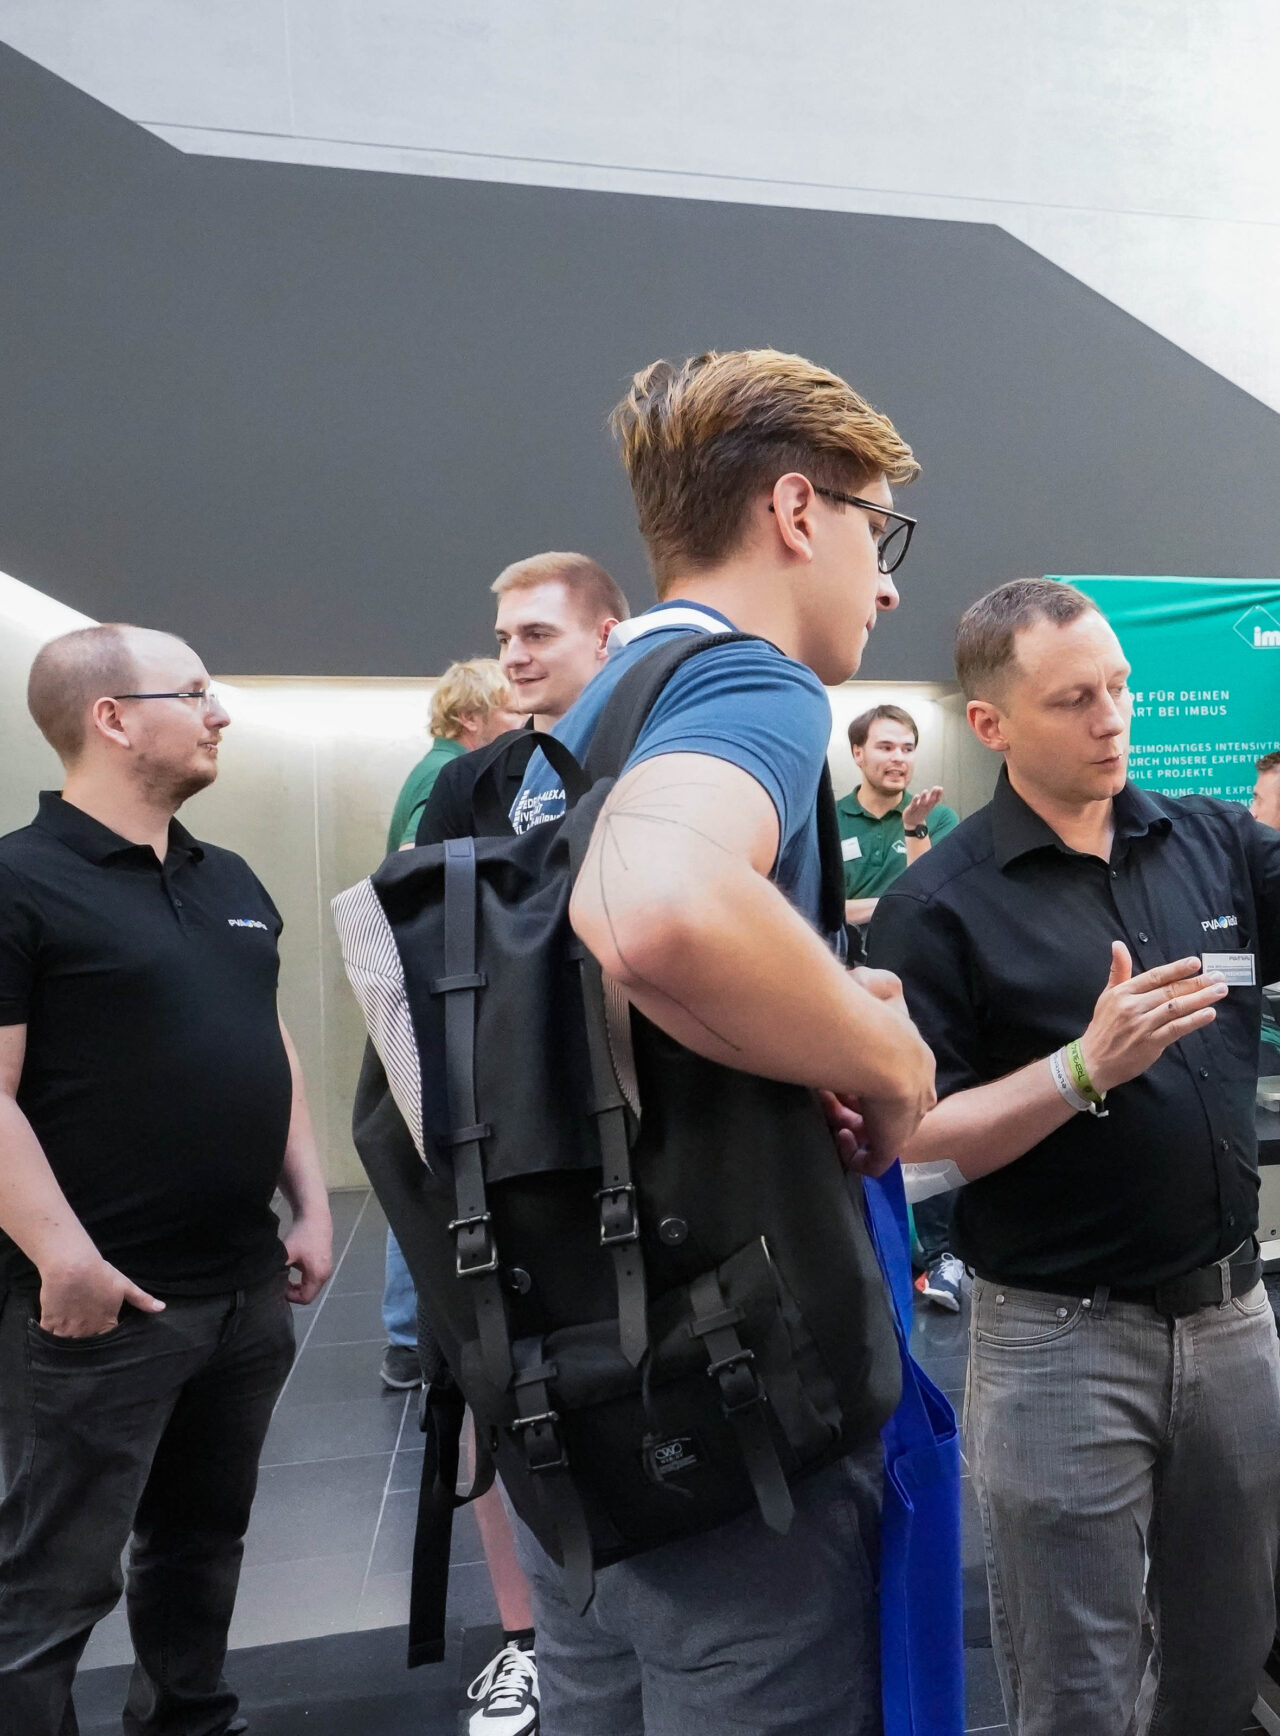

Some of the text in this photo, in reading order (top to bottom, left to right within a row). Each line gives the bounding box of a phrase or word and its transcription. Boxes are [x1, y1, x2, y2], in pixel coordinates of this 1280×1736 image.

[1148, 689, 1175, 702] FÜR
[1180, 690, 1230, 701] DEINEN
[1158, 706, 1180, 717] BEI
[1185, 705, 1228, 717] IMBUS
[1129, 743, 1212, 755] REIMONATIGES
[1129, 757, 1160, 768] URCH
[1163, 755, 1207, 767] UNSERE
[1128, 768, 1214, 780] GILE PROJEKTE
[1199, 786, 1222, 796] ZUM
[1225, 784, 1255, 795] EXPE
[1201, 919, 1221, 932] PVA
